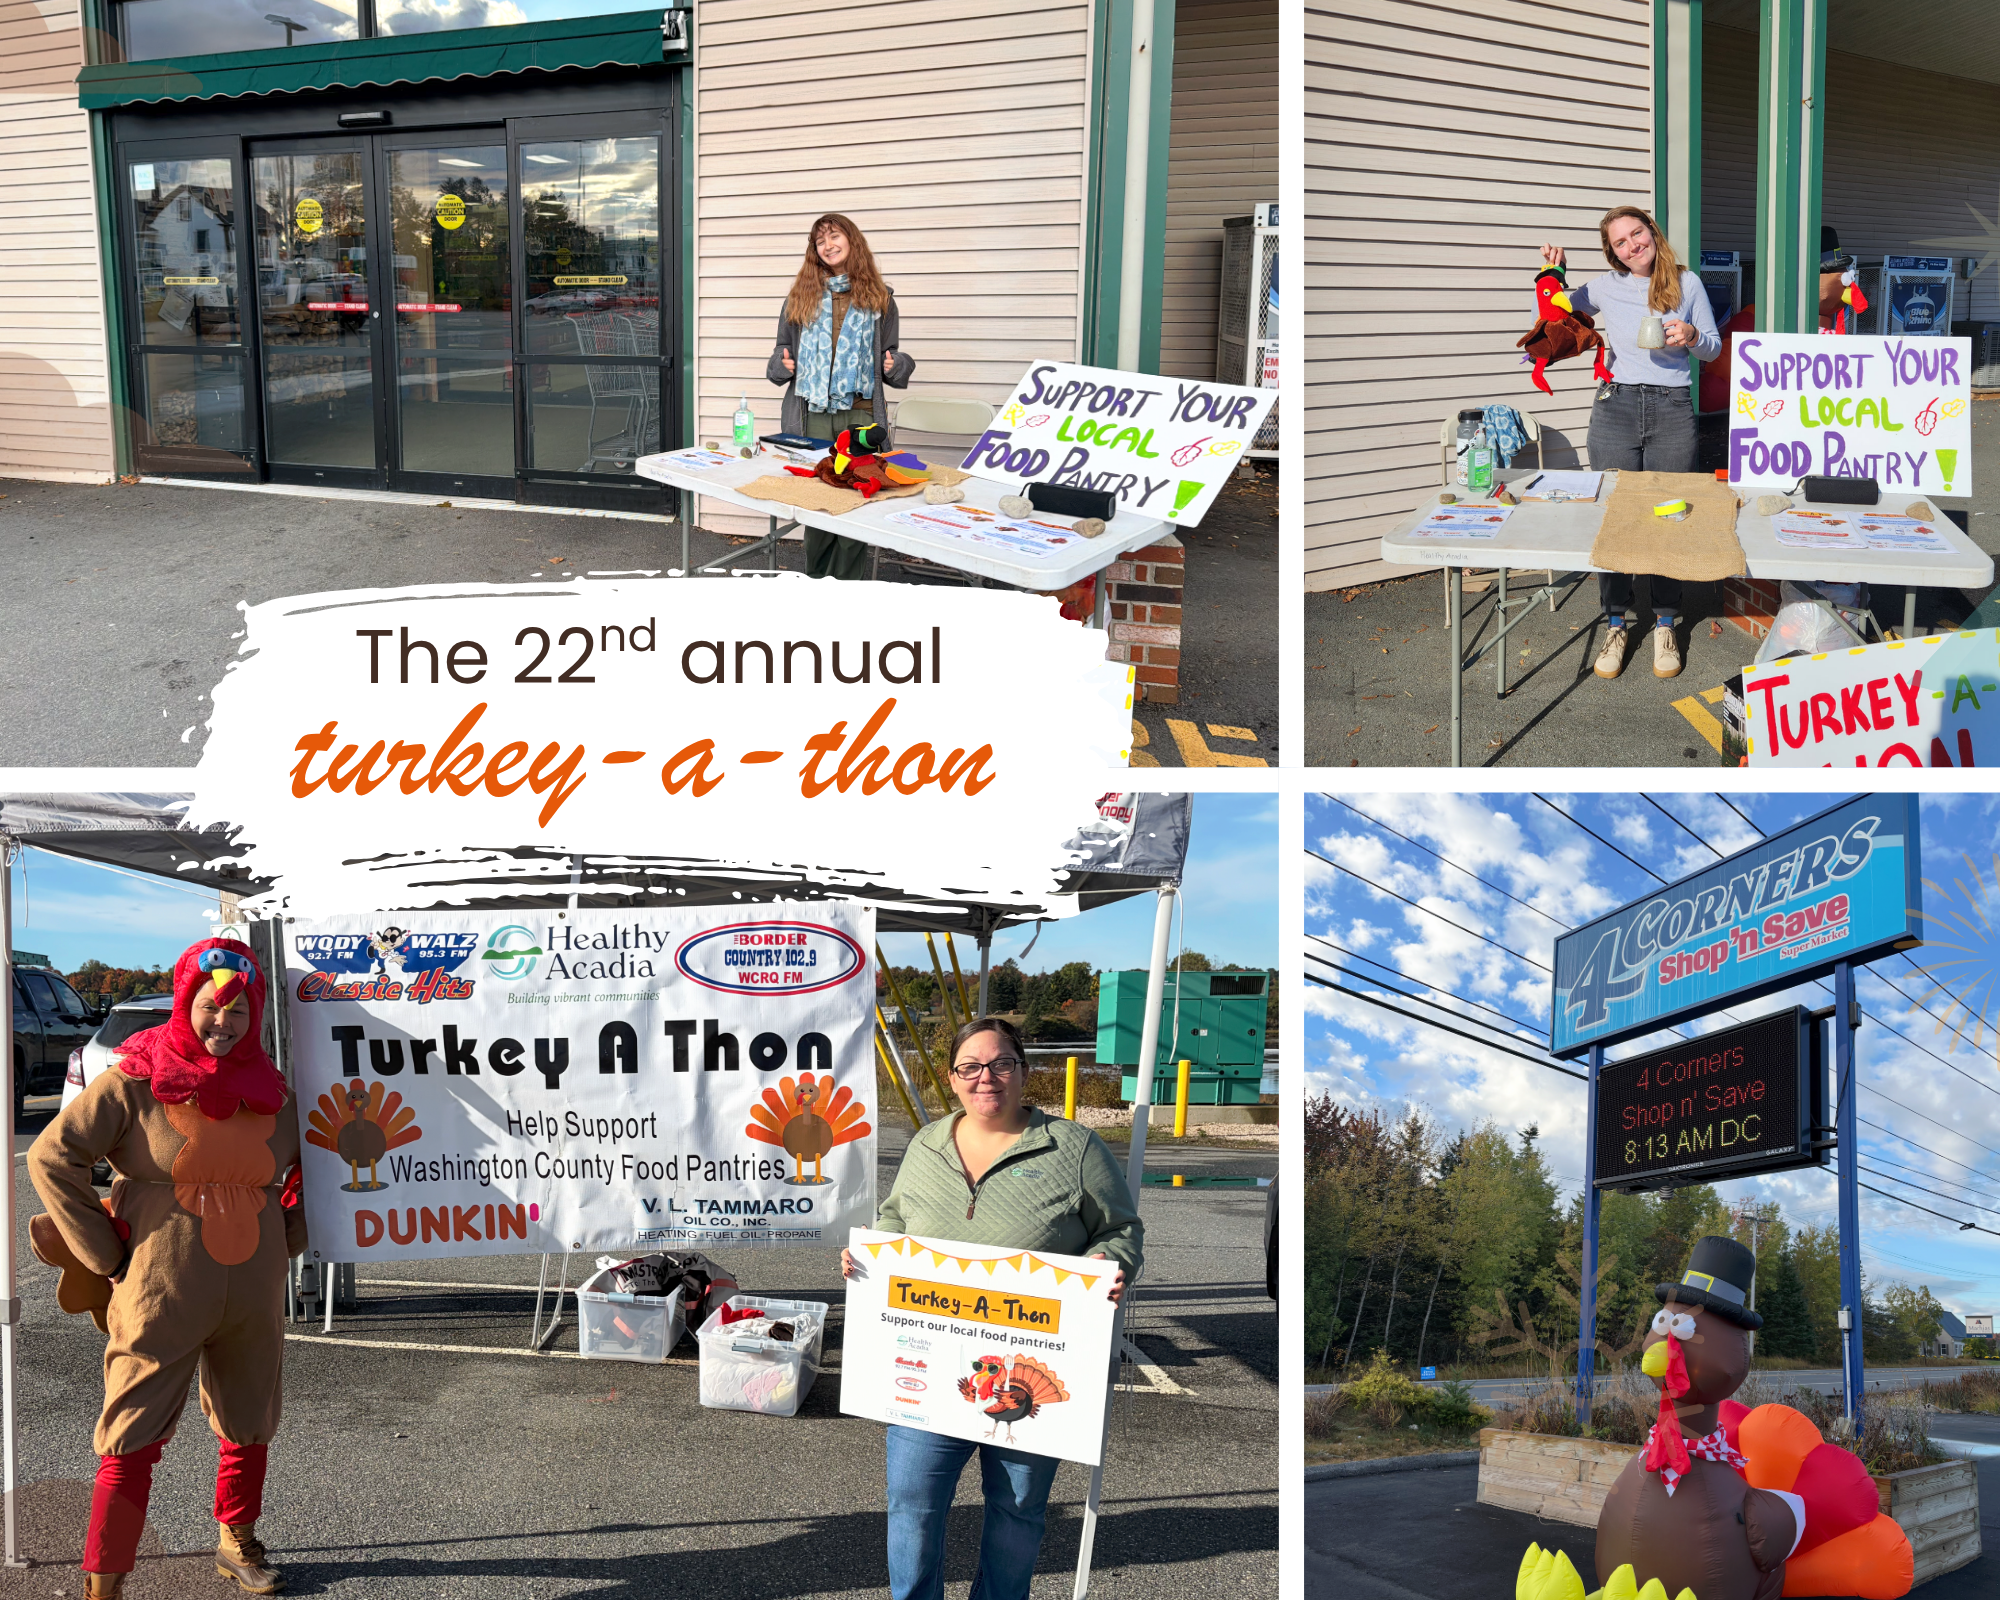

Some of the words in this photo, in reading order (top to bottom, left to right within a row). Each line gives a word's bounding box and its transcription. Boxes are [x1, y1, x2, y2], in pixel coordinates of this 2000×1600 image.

[297, 211, 322, 219] CAUTION
[1911, 307, 1930, 316] Blue
[1263, 369, 1278, 380] NO
[1738, 338, 1875, 392] SUPPORT
[1884, 340, 1961, 388] YOUR
[1019, 365, 1163, 419] SUPPORT
[1169, 383, 1258, 430] YOUR
[1799, 395, 1904, 432] LOCAL
[1056, 415, 1160, 459] LOCAL
[960, 429, 1050, 478] FOOD
[1729, 427, 1812, 483] FOOD
[1099, 805, 1134, 824] nopy
[547, 923, 671, 953] Healthy
[1564, 926, 1647, 1033] 4
[1621, 815, 1882, 969] CORNERS
[297, 936, 365, 952] WQDY
[411, 932, 479, 949] WALZ
[739, 933, 808, 946] BORDER
[1658, 938, 1730, 986] Shop
[1761, 893, 1851, 945] Save
[307, 952, 331, 960] 92.7
[336, 951, 354, 959] FM
[418, 950, 446, 958] 95.3
[450, 949, 468, 958] FM
[545, 951, 657, 980] Acadia
[724, 948, 781, 967] COUNTRY
[785, 949, 817, 967] 102.9
[298, 970, 403, 1001] Classic
[406, 966, 475, 1004] Hits
[738, 971, 779, 985] WCRQ
[783, 971, 803, 984] FM
[507, 992, 550, 1006] Building
[554, 992, 591, 1003] vibrant
[594, 990, 660, 1002] communities
[331, 1024, 569, 1090] Turkey
[598, 1020, 638, 1074] A
[664, 1018, 833, 1073] Thon
[1636, 1067, 1649, 1090] 4
[1656, 1046, 1744, 1086] Corners
[1622, 1102, 1674, 1131] Shop
[1681, 1090, 1698, 1117] n'
[1705, 1080, 1765, 1111] Save
[506, 1108, 558, 1144] Help
[565, 1110, 658, 1144] Support
[1624, 1133, 1669, 1165] 8:13
[1676, 1123, 1713, 1155] AM
[1721, 1114, 1762, 1147] DC
[389, 1153, 527, 1187] Washington
[534, 1151, 615, 1185] County
[621, 1154, 679, 1181] Food
[687, 1153, 786, 1182] Pantries
[1668, 1162, 1704, 1172] DAKTRONICS
[642, 1198, 662, 1214] V.
[669, 1198, 688, 1213] L.
[694, 1197, 814, 1215] TAMMARO
[355, 1203, 540, 1248] DUNKIN'
[638, 1230, 697, 1240] HEATING
[705, 1230, 737, 1240] FUEL
[740, 1230, 762, 1239] OIL
[767, 1230, 821, 1239] PROPANE
[683, 1216, 706, 1226] OIL
[710, 1217, 739, 1228] CO.,
[743, 1218, 771, 1226] INC.
[896, 1283, 1051, 1325] Turkey-A-Thon
[881, 1313, 925, 1329] Support
[927, 1322, 948, 1332] our
[950, 1324, 977, 1338] local
[981, 1329, 1008, 1342] food
[1010, 1337, 1066, 1352] pantries!
[908, 1336, 932, 1347] Healthy
[908, 1343, 930, 1351] Acadia
[895, 1396, 921, 1405] DUNKIN'
[900, 1413, 925, 1423] TAMMARO
